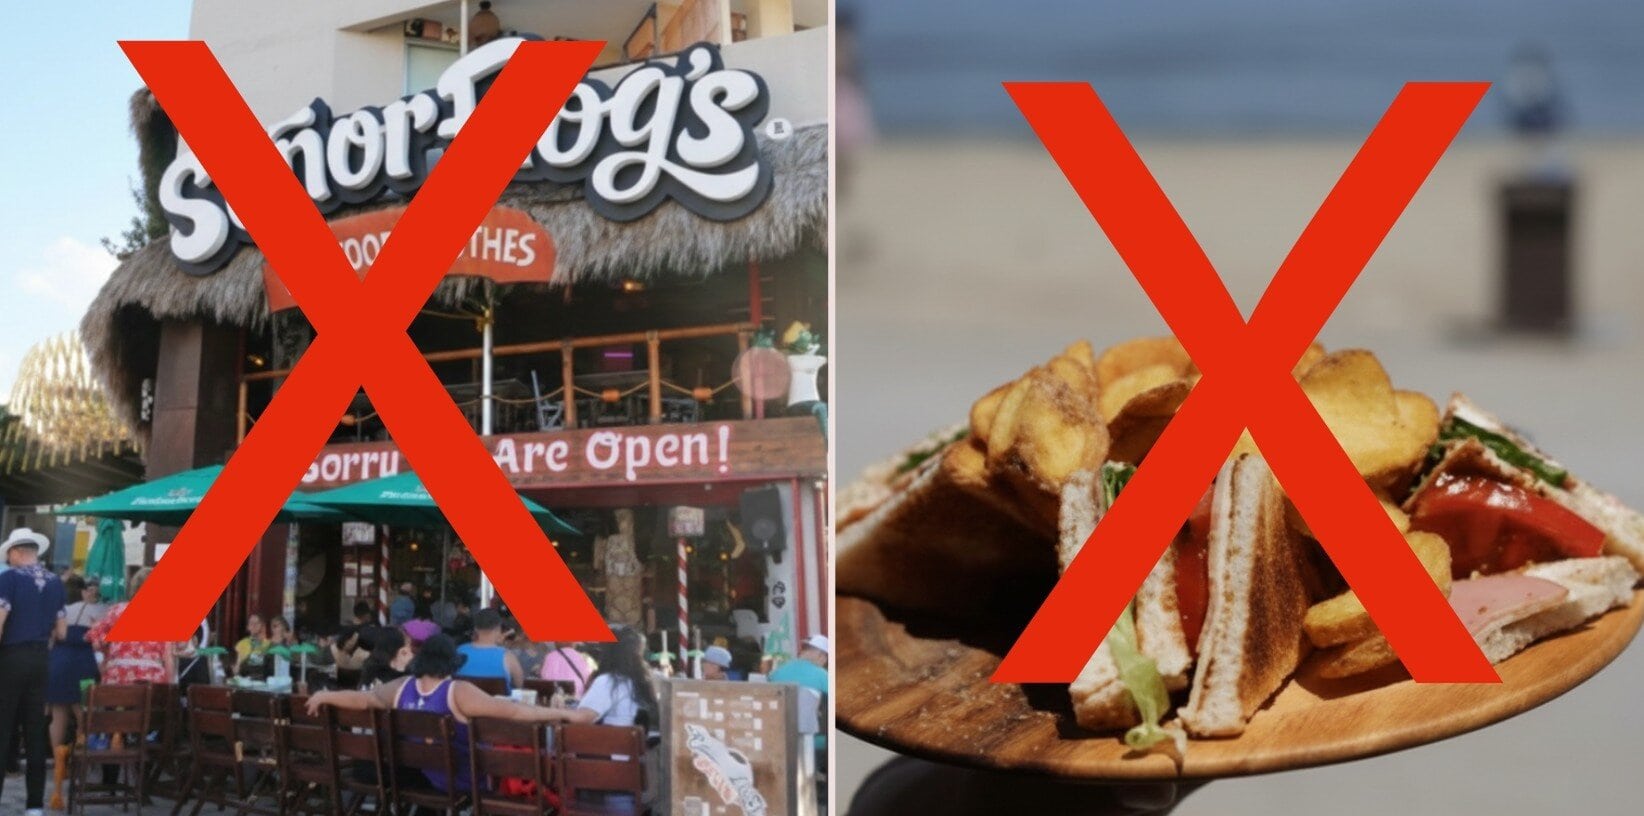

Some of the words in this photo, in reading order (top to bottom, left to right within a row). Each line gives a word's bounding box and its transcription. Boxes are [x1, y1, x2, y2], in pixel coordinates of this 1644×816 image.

[159, 92, 438, 265] Sñor
[338, 230, 391, 271] OO
[458, 226, 537, 267] THES
[493, 437, 569, 474] Are
[586, 425, 730, 482] Open!
